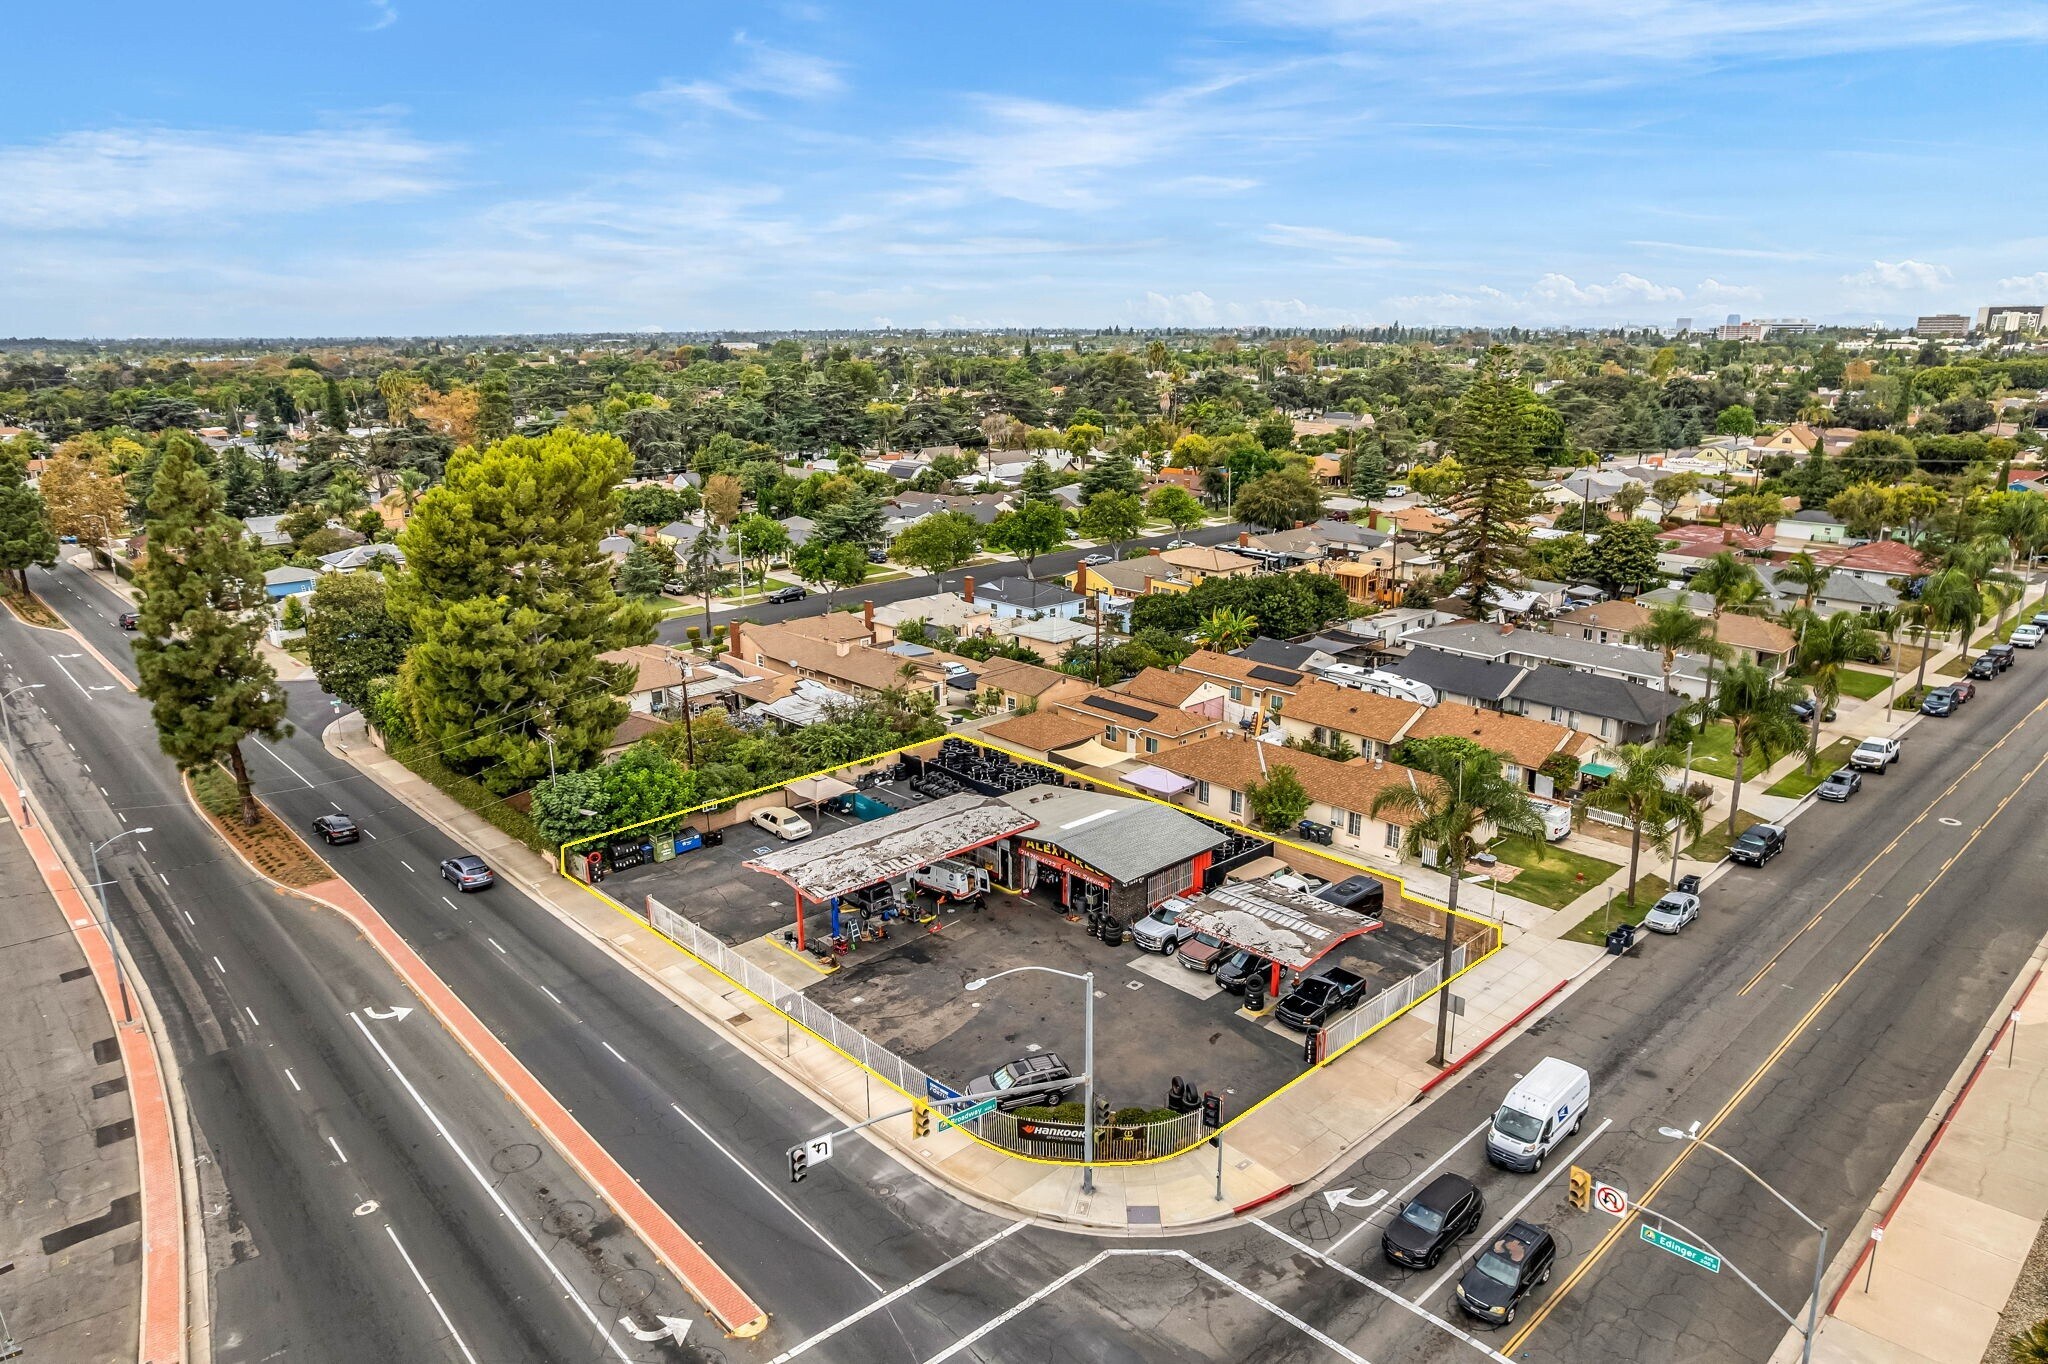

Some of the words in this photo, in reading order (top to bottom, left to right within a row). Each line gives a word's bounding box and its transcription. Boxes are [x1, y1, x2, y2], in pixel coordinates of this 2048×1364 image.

[1025, 840, 1059, 857] ALEX
[929, 1087, 951, 1100] FORTU
[950, 1108, 982, 1123] Broadway
[1659, 1236, 1697, 1260] Edinger
[1703, 1255, 1714, 1264] AVE
